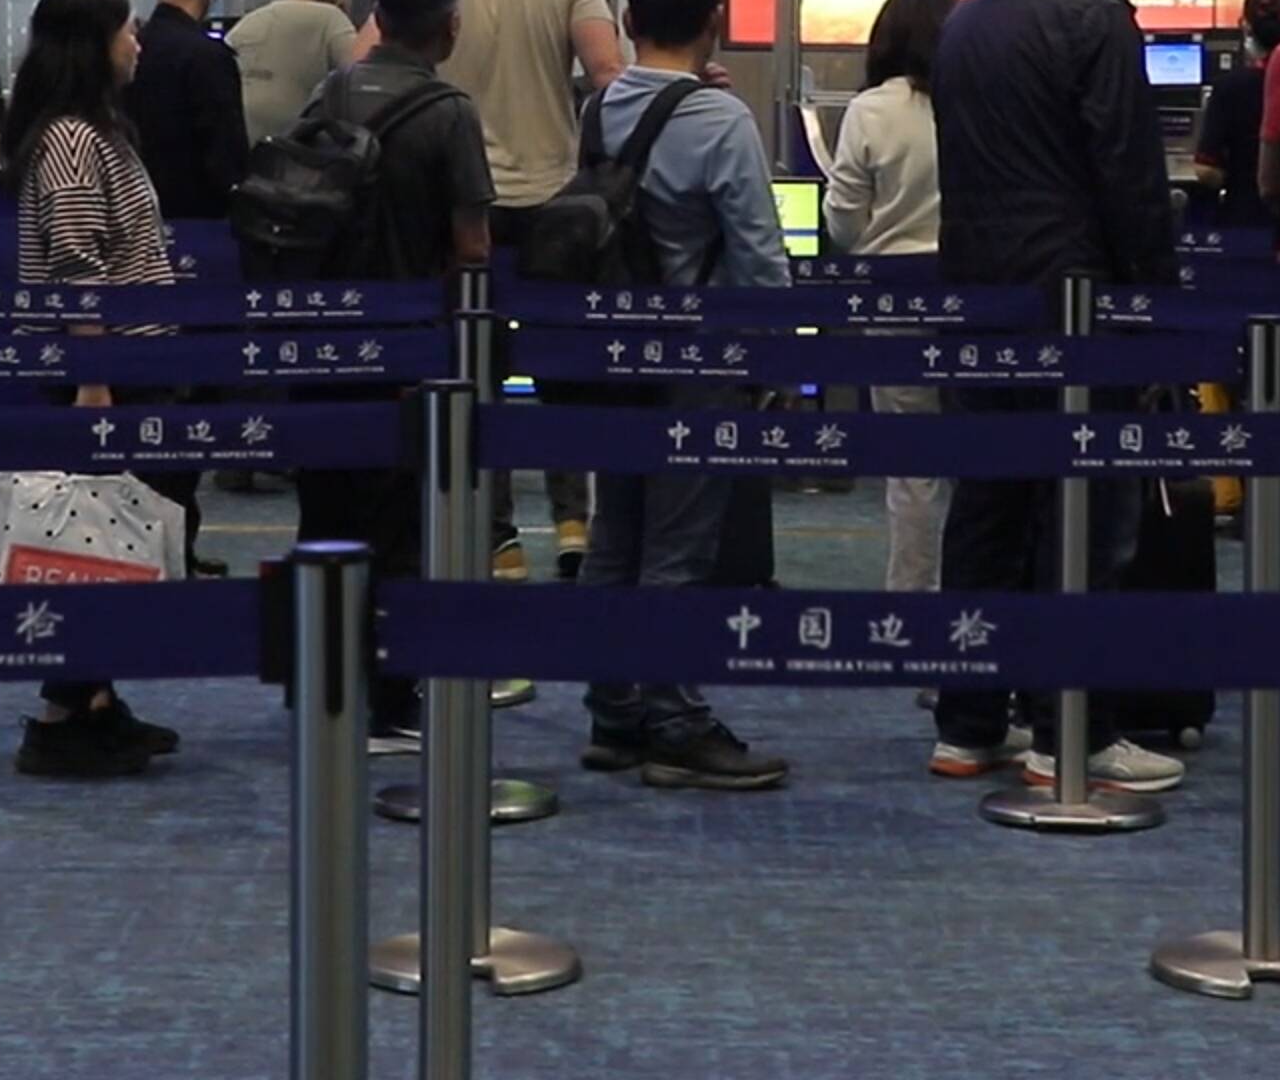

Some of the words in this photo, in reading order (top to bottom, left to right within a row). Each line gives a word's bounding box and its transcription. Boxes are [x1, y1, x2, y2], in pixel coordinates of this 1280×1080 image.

[91, 416, 273, 447] 中国边检
[667, 420, 847, 452] 中国边检
[1072, 423, 1252, 454] 中国边检
[726, 605, 996, 652] 中国边检
[727, 658, 775, 670] CHINA
[786, 659, 893, 672] IMMIGRATION
[903, 661, 998, 673] INSPECTION
